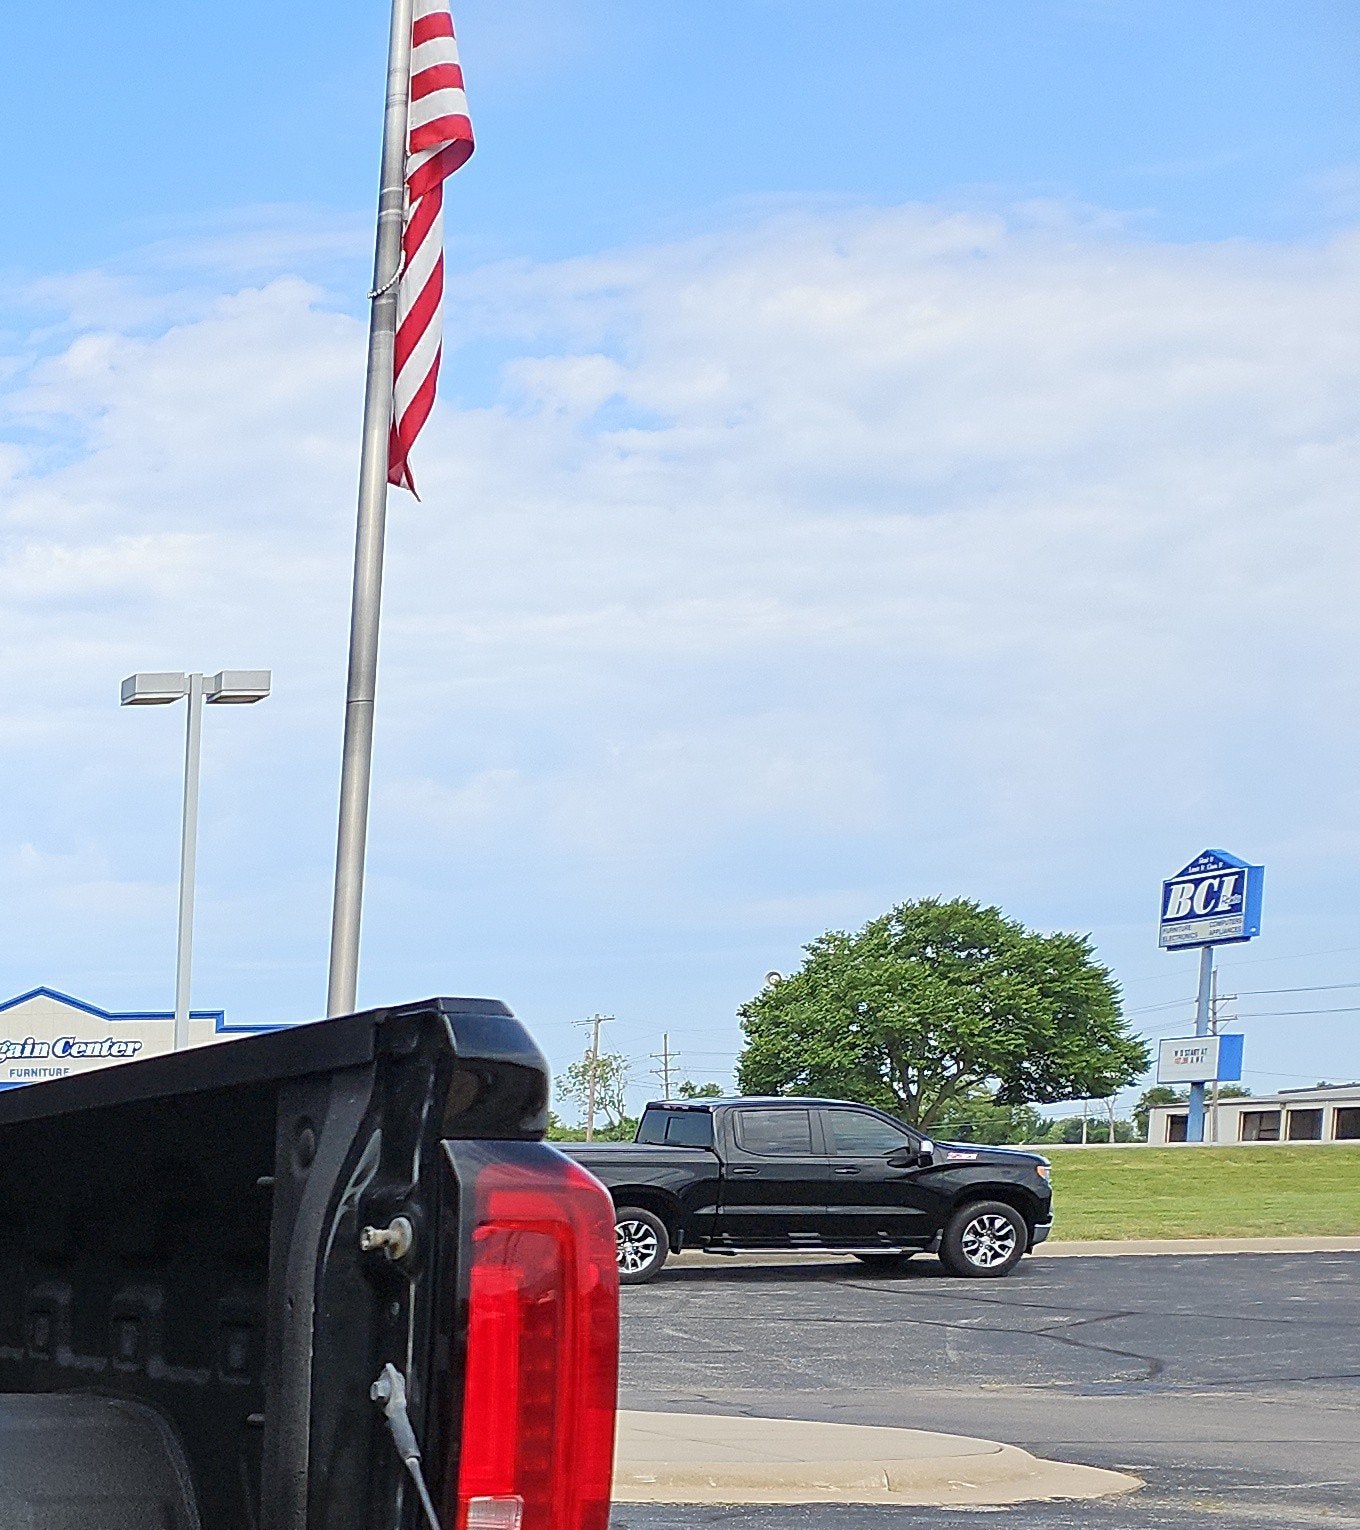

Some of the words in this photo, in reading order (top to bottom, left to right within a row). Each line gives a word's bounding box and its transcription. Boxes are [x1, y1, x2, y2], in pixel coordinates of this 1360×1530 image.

[1208, 918, 1242, 928] COMPUTERS
[1162, 925, 1191, 934] FURNITURE
[1208, 926, 1242, 936] APPLIANCES
[1162, 932, 1198, 942] ELECTRONICS
[51, 1036, 143, 1059] Center
[8, 1067, 71, 1078] FURNITURE
